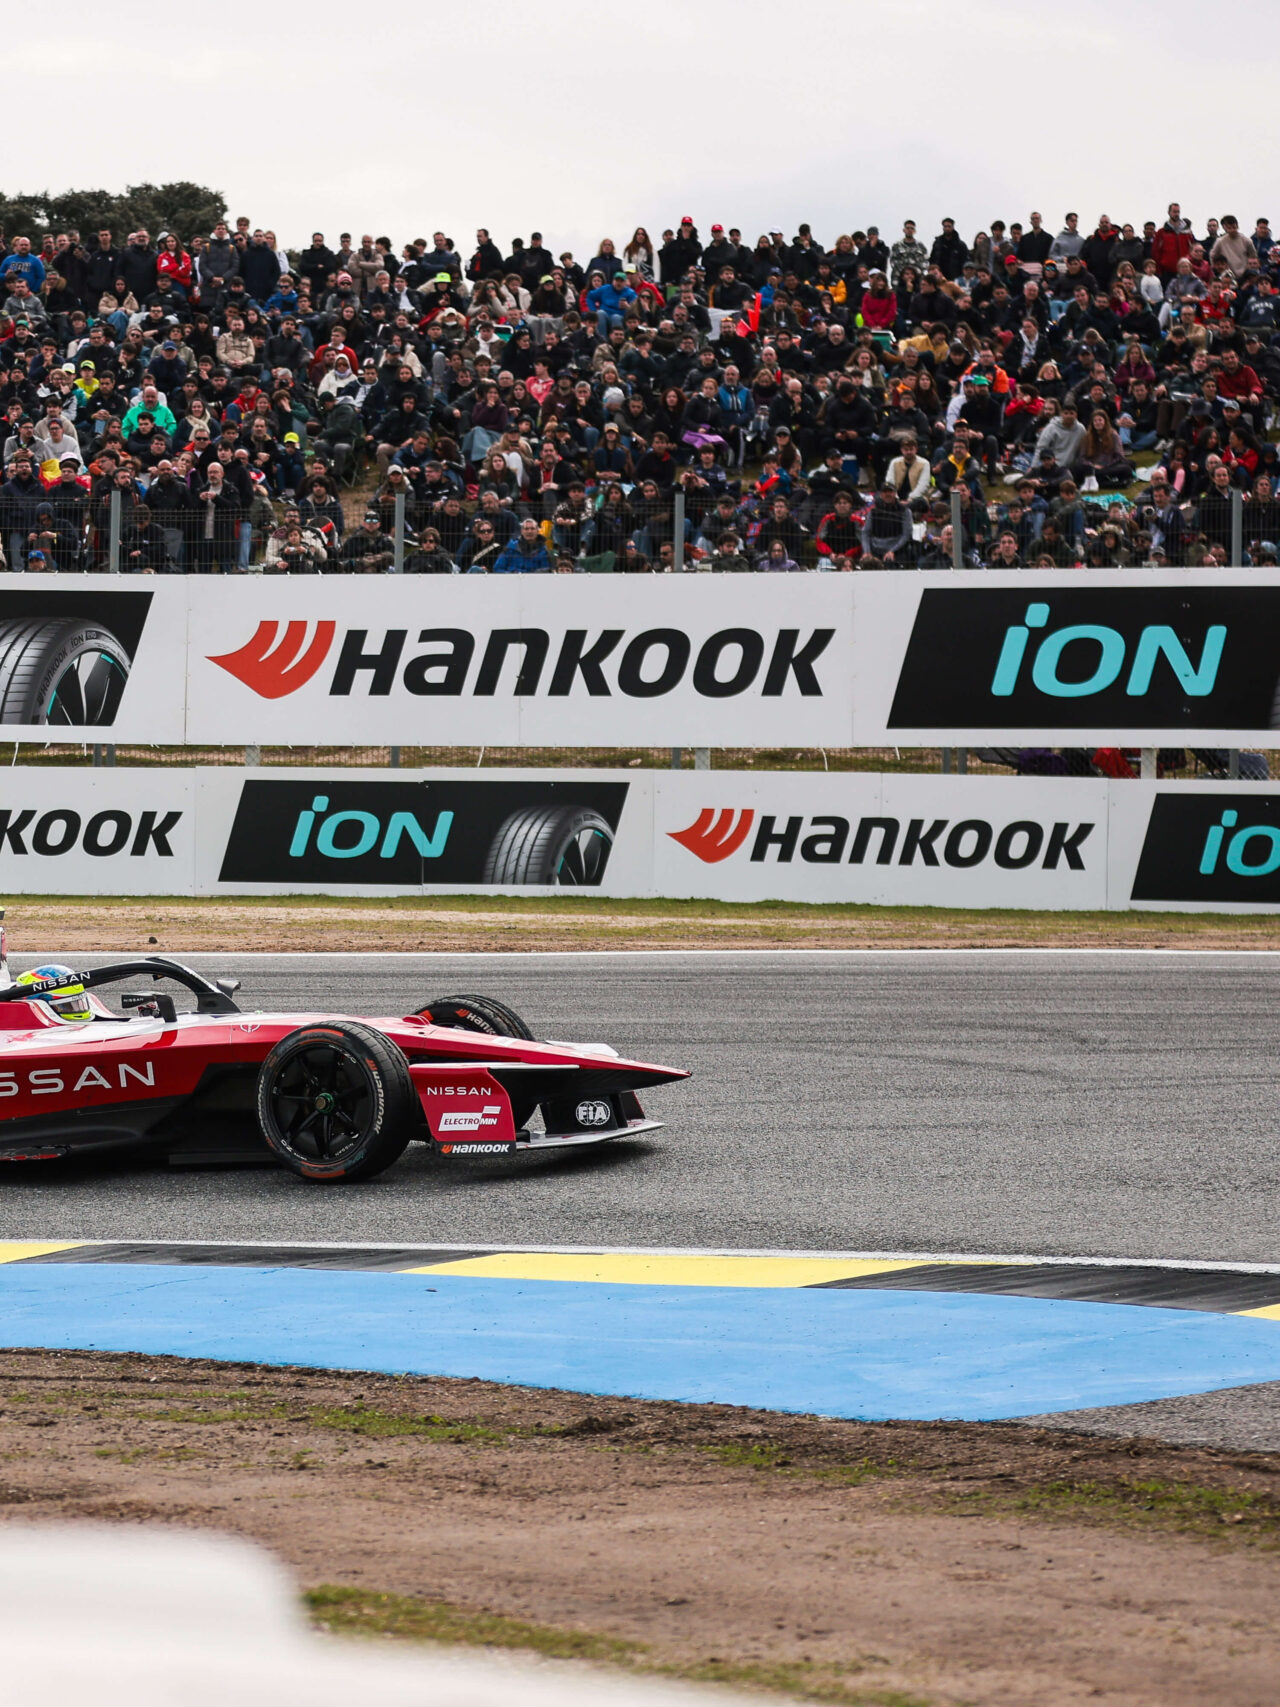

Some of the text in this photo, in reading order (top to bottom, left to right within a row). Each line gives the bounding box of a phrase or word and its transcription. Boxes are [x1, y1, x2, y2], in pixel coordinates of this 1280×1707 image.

[990, 602, 1227, 697] iON
[289, 795, 455, 858] iON
[1199, 809, 1280, 876] iO
[33, 971, 91, 992] NISSAN
[427, 1086, 492, 1097] NISSAN
[443, 1117, 498, 1126] ELECTROMIN
